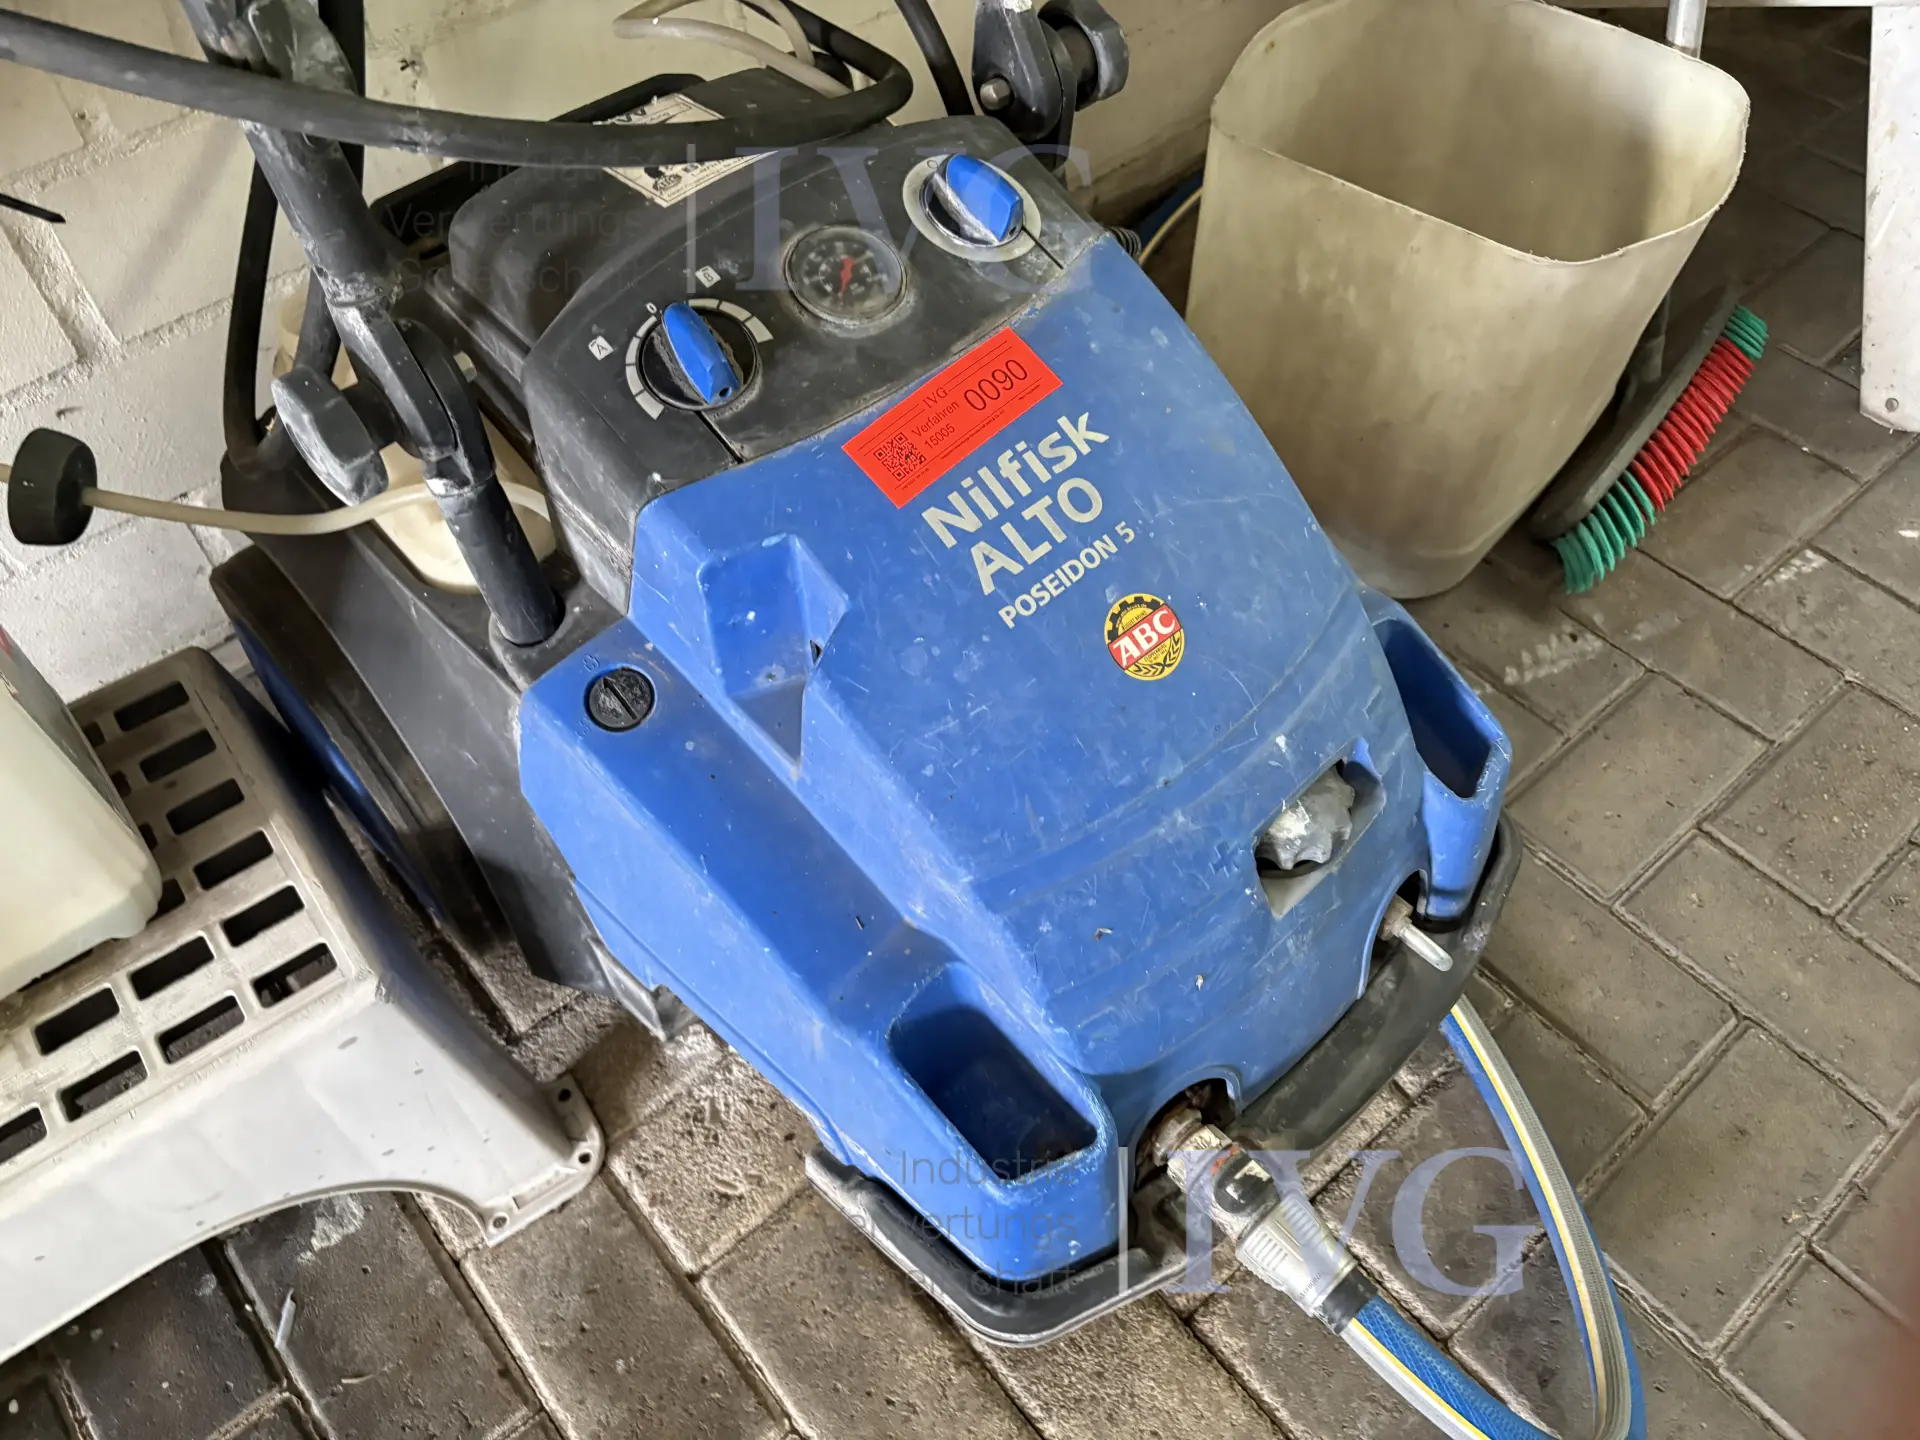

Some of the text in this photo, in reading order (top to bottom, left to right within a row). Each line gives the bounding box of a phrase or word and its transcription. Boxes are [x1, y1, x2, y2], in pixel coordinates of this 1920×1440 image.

[922, 386, 948, 409] IVG
[963, 359, 1028, 411] 0090
[911, 401, 960, 437] Verfahren
[924, 423, 956, 449] 15005
[921, 411, 1110, 549] Nilfisk
[969, 477, 1104, 596] ALTO
[998, 521, 1136, 629] POSEIDON 5
[1112, 609, 1176, 668] ABC
